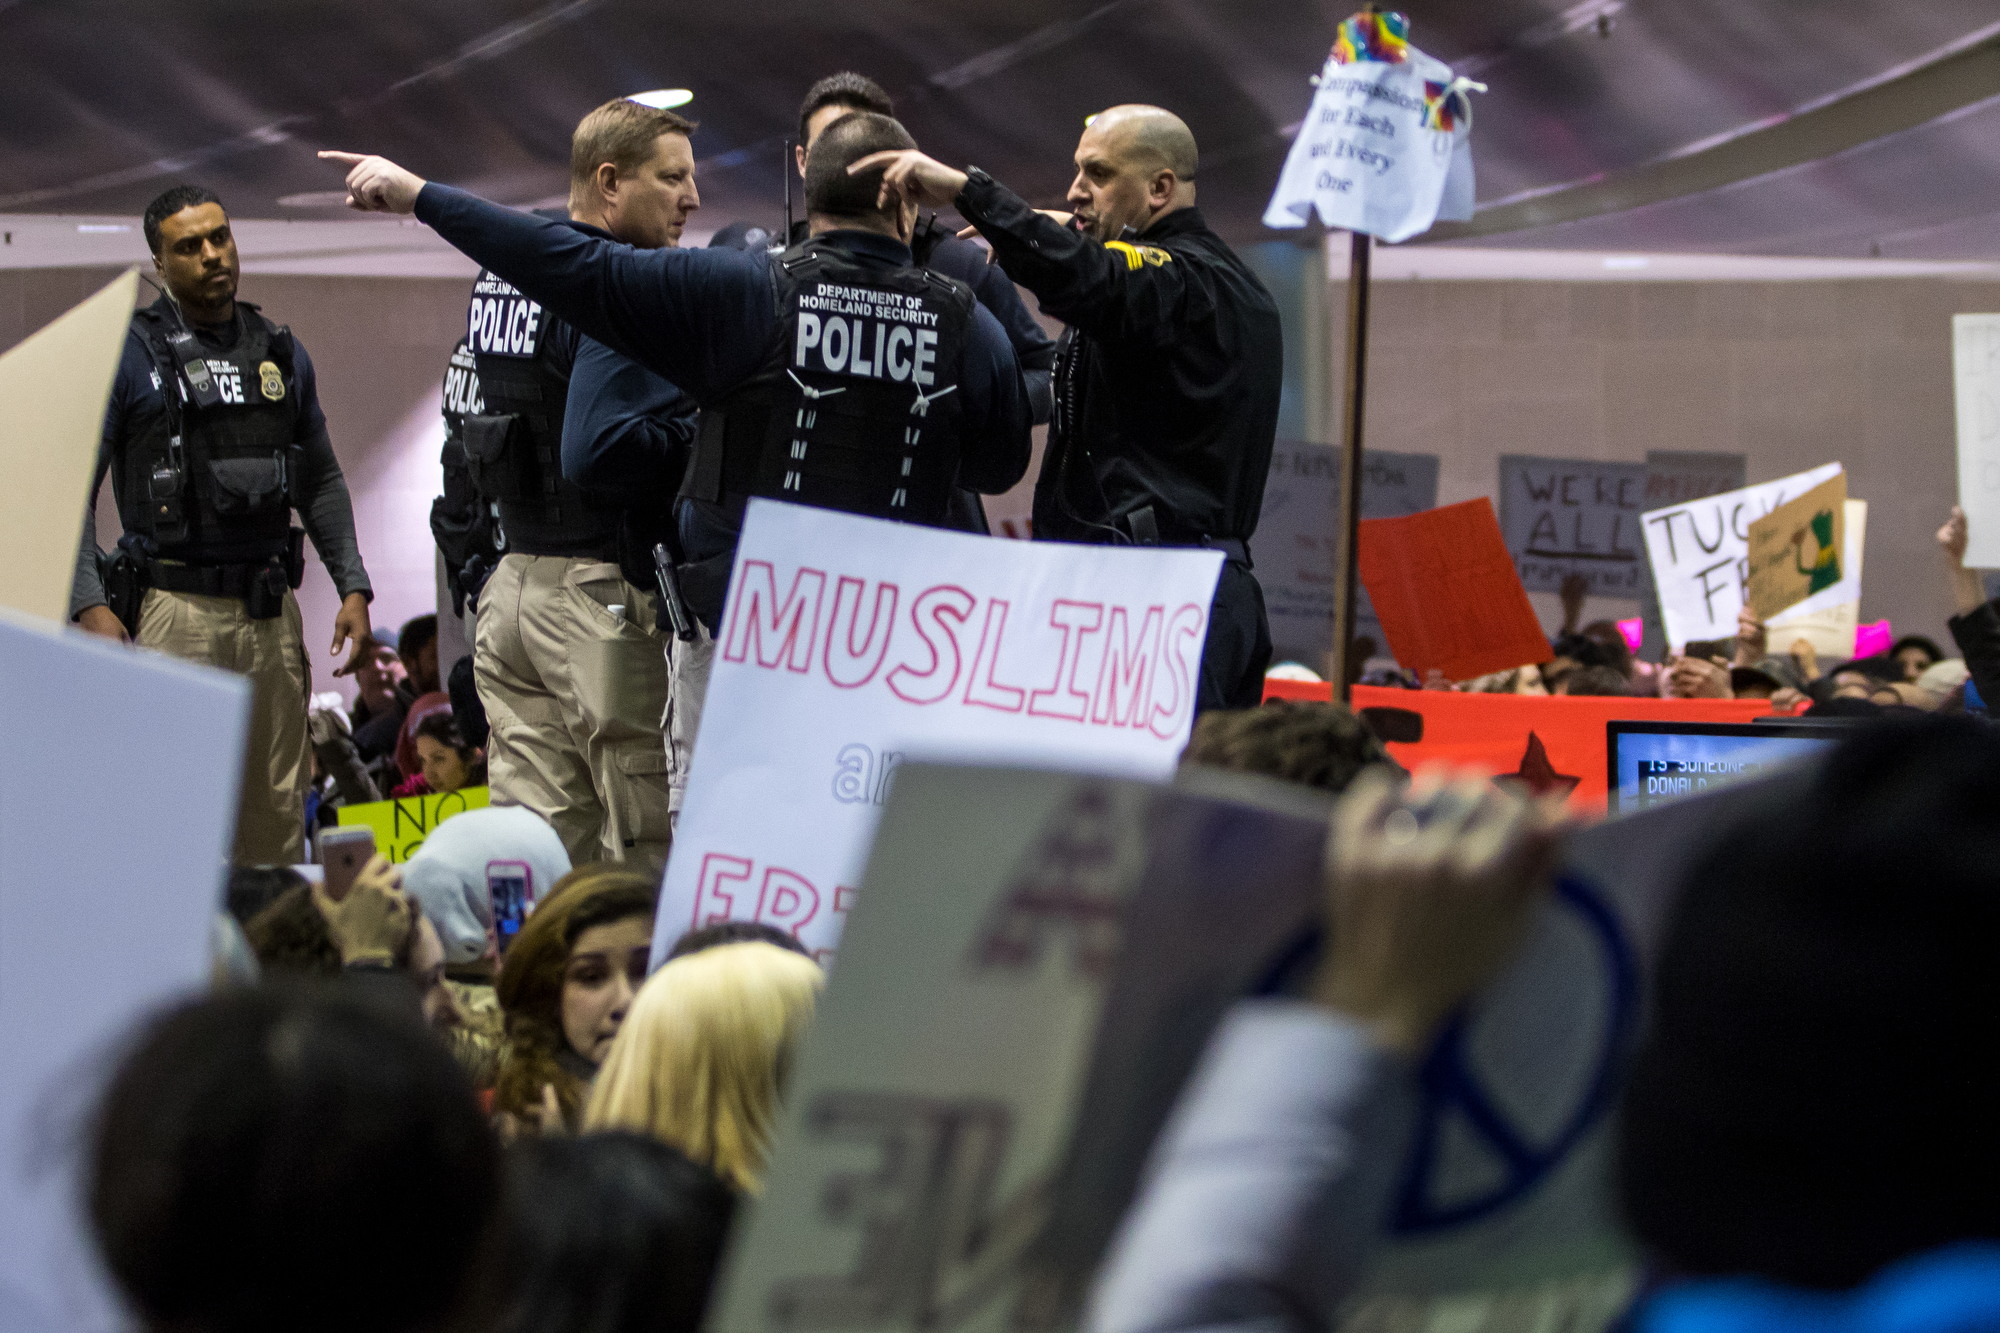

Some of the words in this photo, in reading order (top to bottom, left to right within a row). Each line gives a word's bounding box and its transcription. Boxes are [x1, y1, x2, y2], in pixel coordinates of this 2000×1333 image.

[1317, 170, 1353, 193] One
[799, 295, 872, 316] HOMELAND
[875, 307, 938, 326] SECURITY
[817, 284, 903, 305] DEPARTMENT
[905, 297, 922, 309] OF
[469, 298, 541, 354] POLICE
[796, 312, 938, 386] POLICE
[442, 366, 487, 416] POLIC
[1520, 469, 1641, 516] WE'RE
[1527, 510, 1636, 554] ALL
[723, 559, 1204, 740] MUSLIMS
